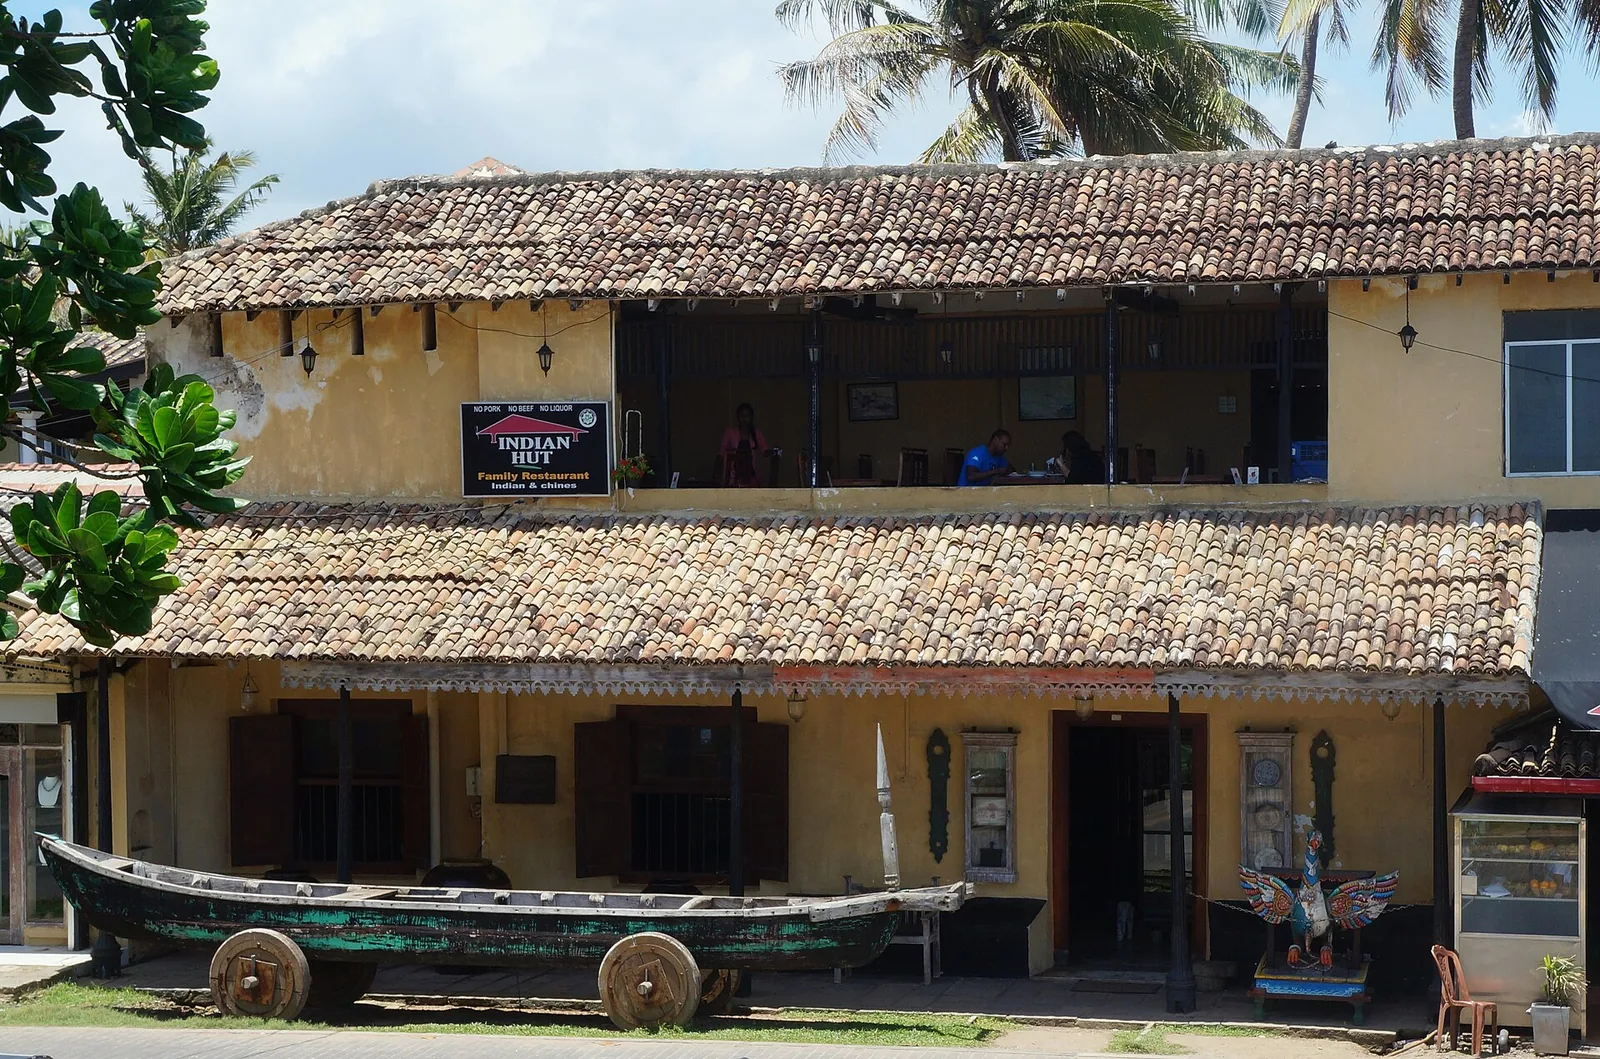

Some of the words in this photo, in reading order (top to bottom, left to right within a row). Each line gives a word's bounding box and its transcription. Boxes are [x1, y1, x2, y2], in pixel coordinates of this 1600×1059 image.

[498, 437, 570, 450] INDIAN
[511, 451, 553, 464] HUT
[478, 472, 518, 482] Family
[522, 472, 590, 480] Restaurant
